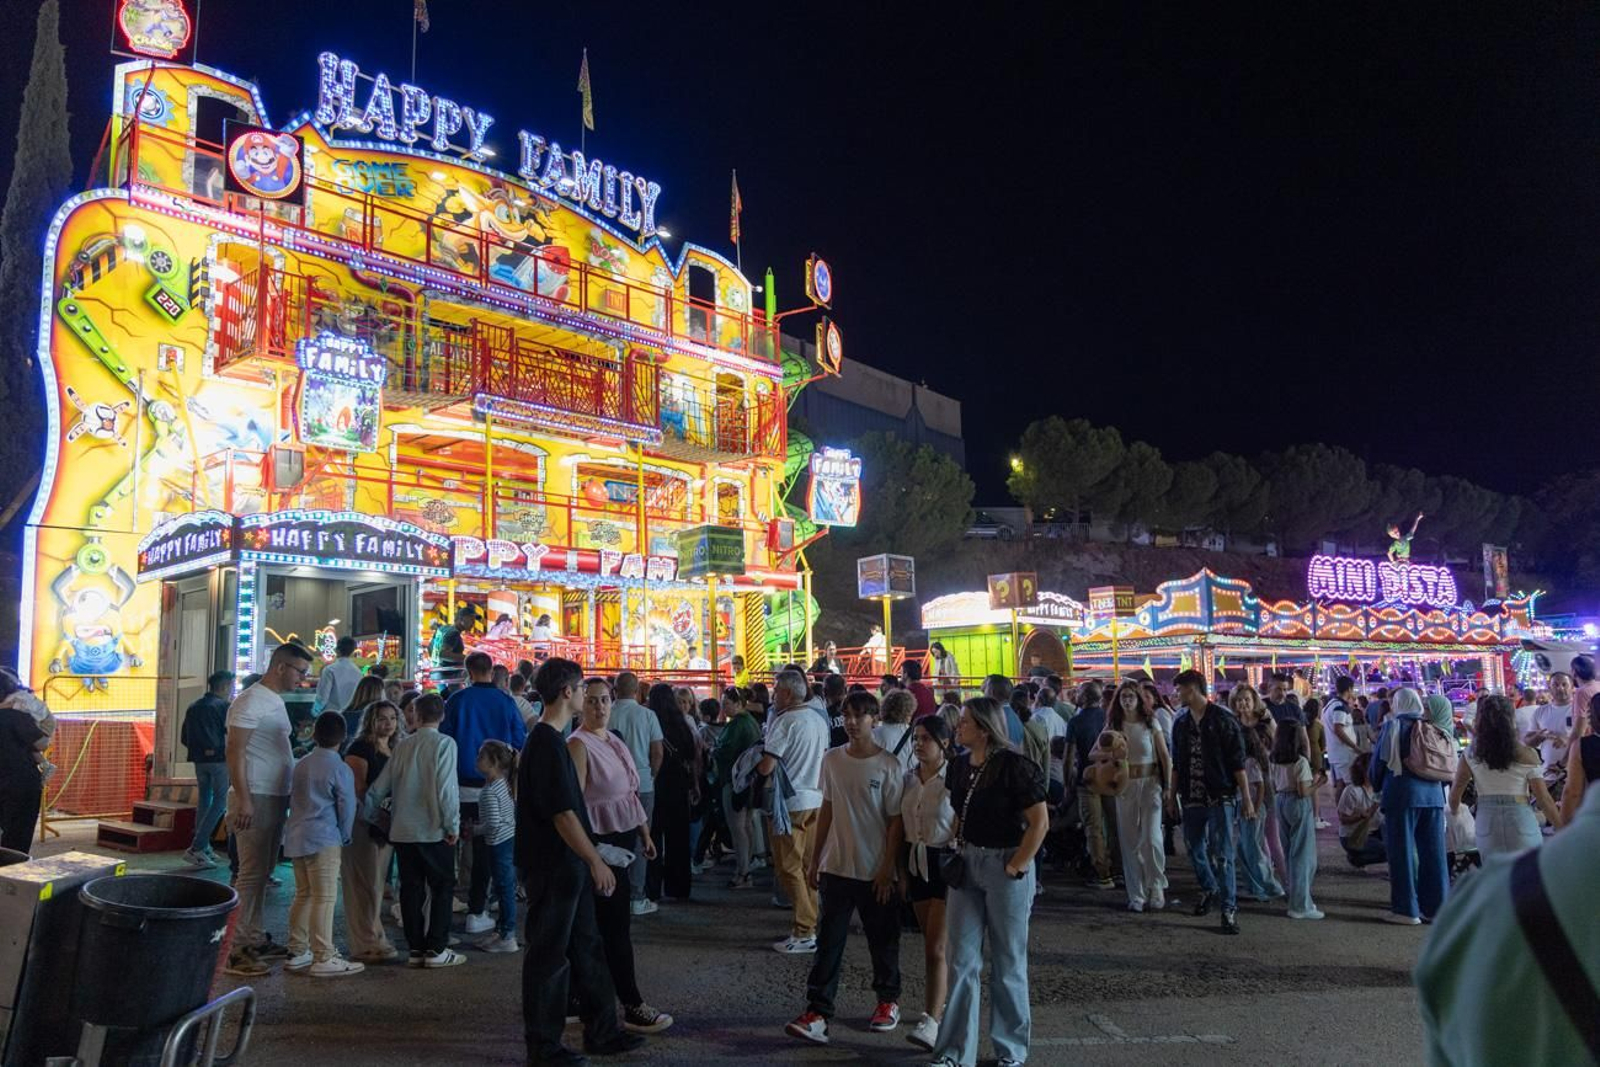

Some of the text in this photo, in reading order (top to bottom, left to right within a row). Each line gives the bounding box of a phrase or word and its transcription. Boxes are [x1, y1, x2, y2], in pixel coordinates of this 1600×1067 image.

[315, 52, 661, 237] HAPPY FAMILY
[333, 159, 409, 178] GAME
[335, 177, 415, 197] OVER
[156, 292, 181, 317] 220
[147, 537, 182, 565] HAPPY
[711, 544, 741, 557] NITRO
[1308, 555, 1377, 601] MINI
[1116, 596, 1132, 608] TNT
